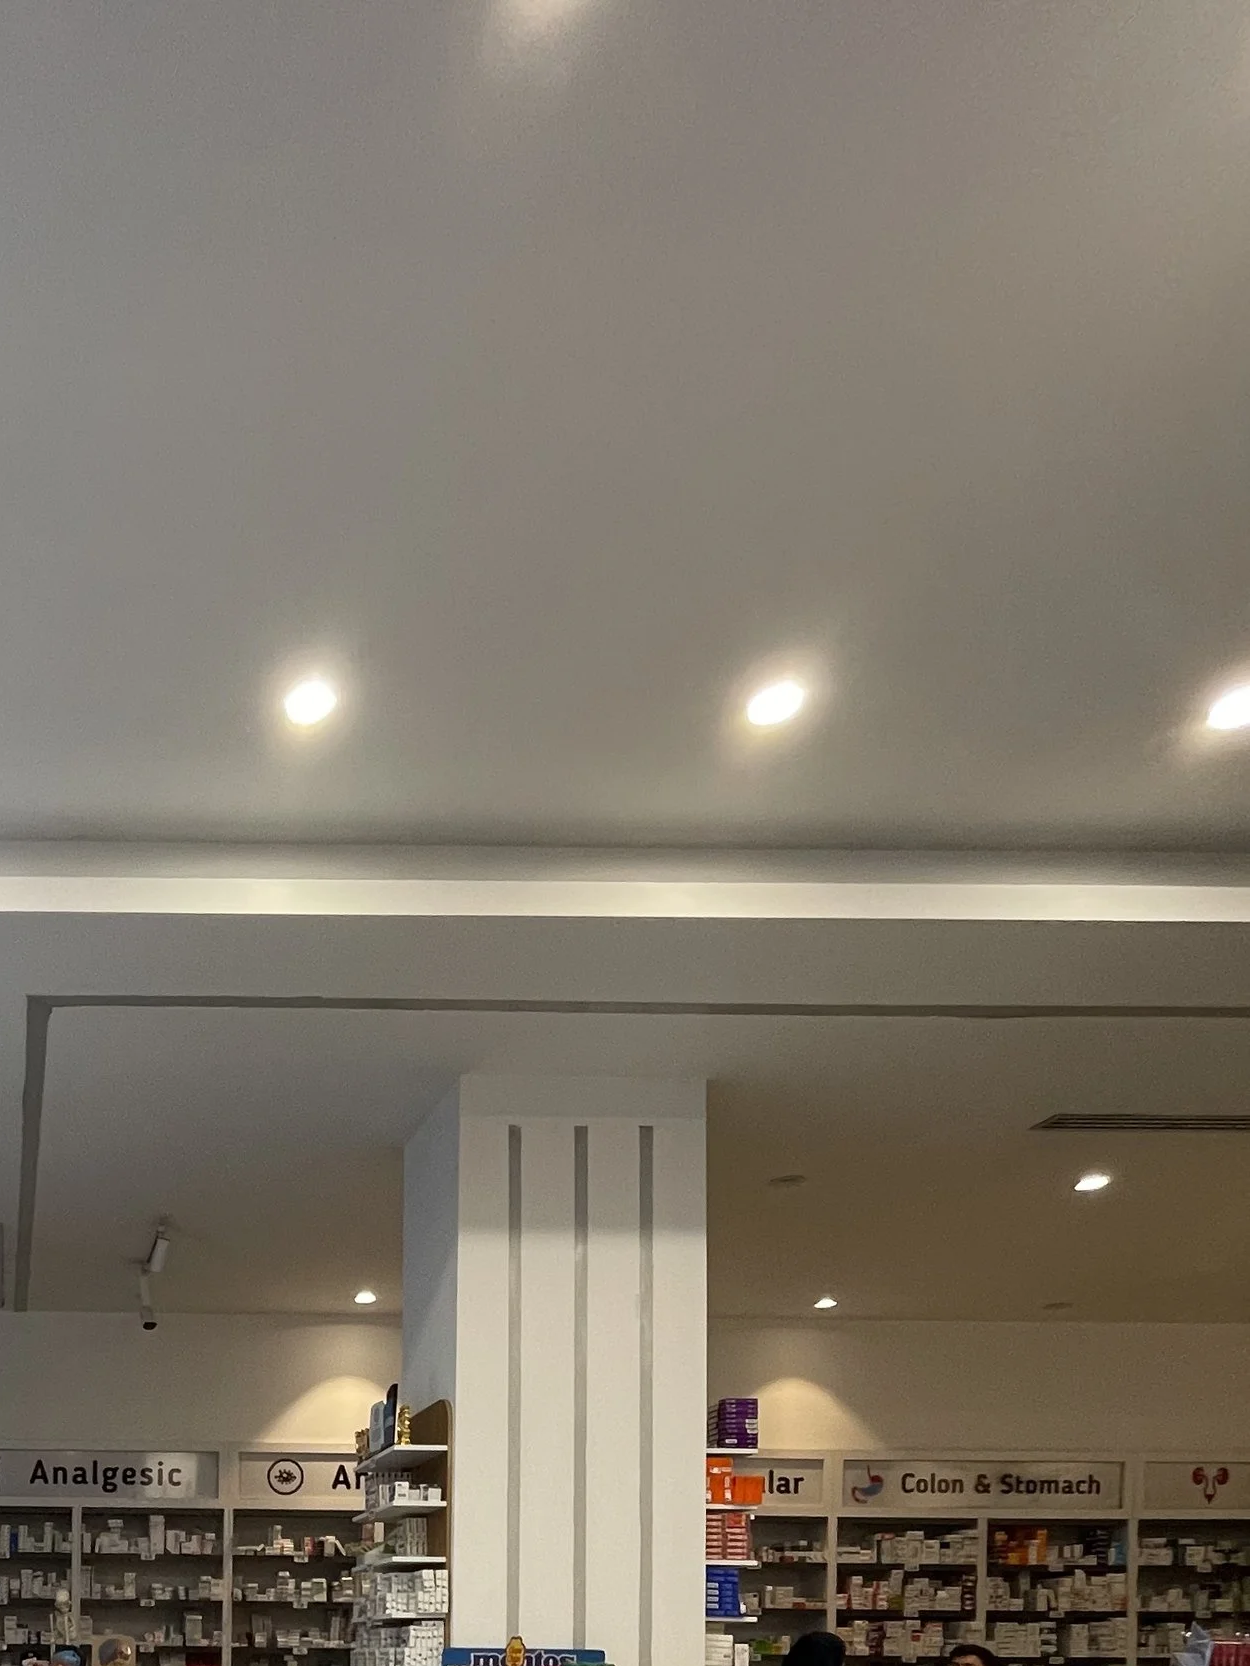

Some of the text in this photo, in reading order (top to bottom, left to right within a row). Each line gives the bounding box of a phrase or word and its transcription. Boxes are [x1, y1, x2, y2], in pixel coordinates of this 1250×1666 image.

[29, 1458, 183, 1494] Analgesic
[901, 1472, 1101, 1495] Colon & Stomach
